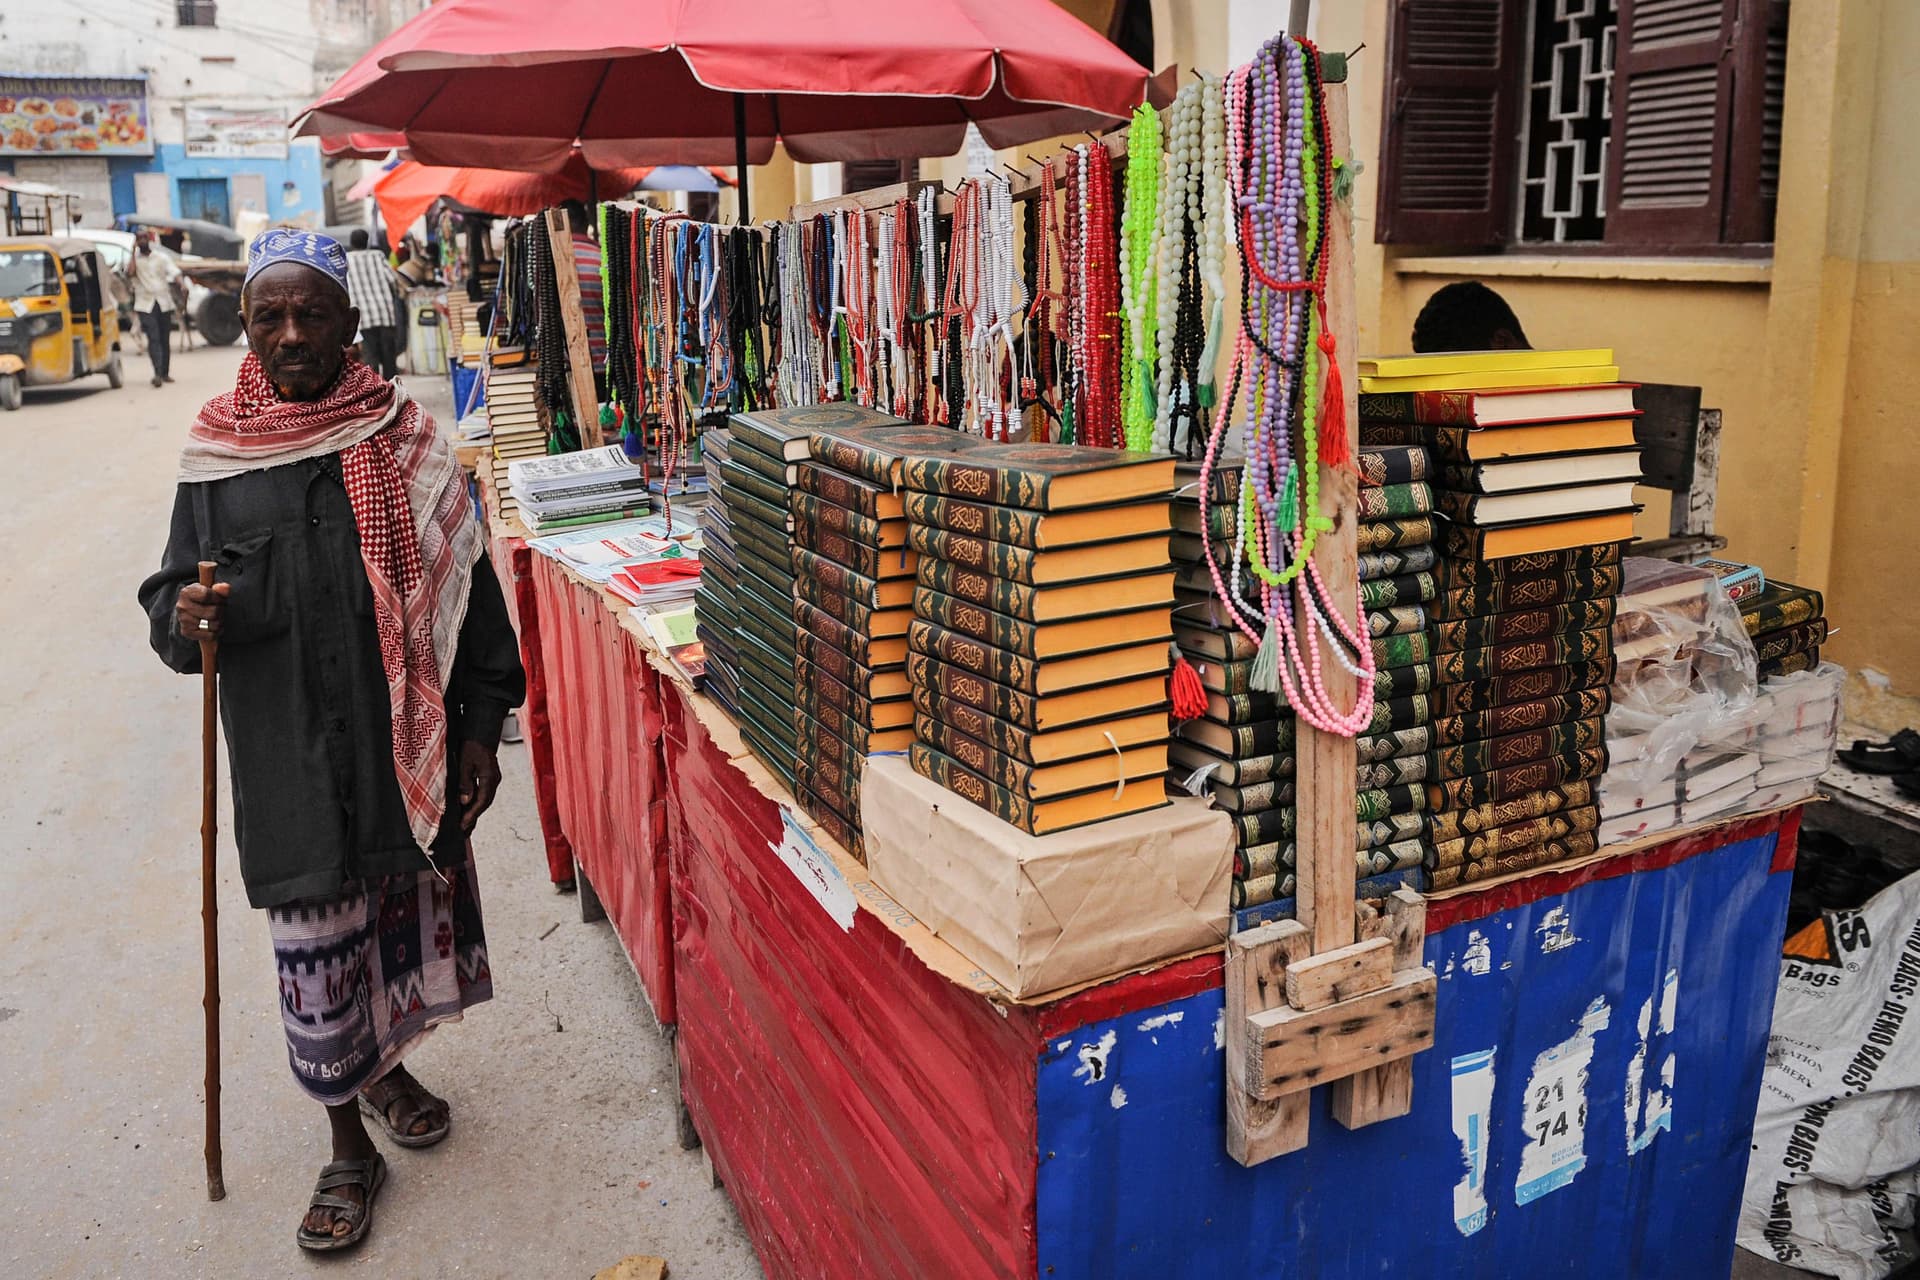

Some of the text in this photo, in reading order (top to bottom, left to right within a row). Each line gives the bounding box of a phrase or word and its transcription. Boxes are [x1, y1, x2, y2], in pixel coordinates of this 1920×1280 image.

[1785, 963, 1841, 987] Bags
[1842, 1000, 1907, 1092] DEMO BAGS
[1535, 1110, 1568, 1147] 74
[1782, 1124, 1820, 1172] BAGS
